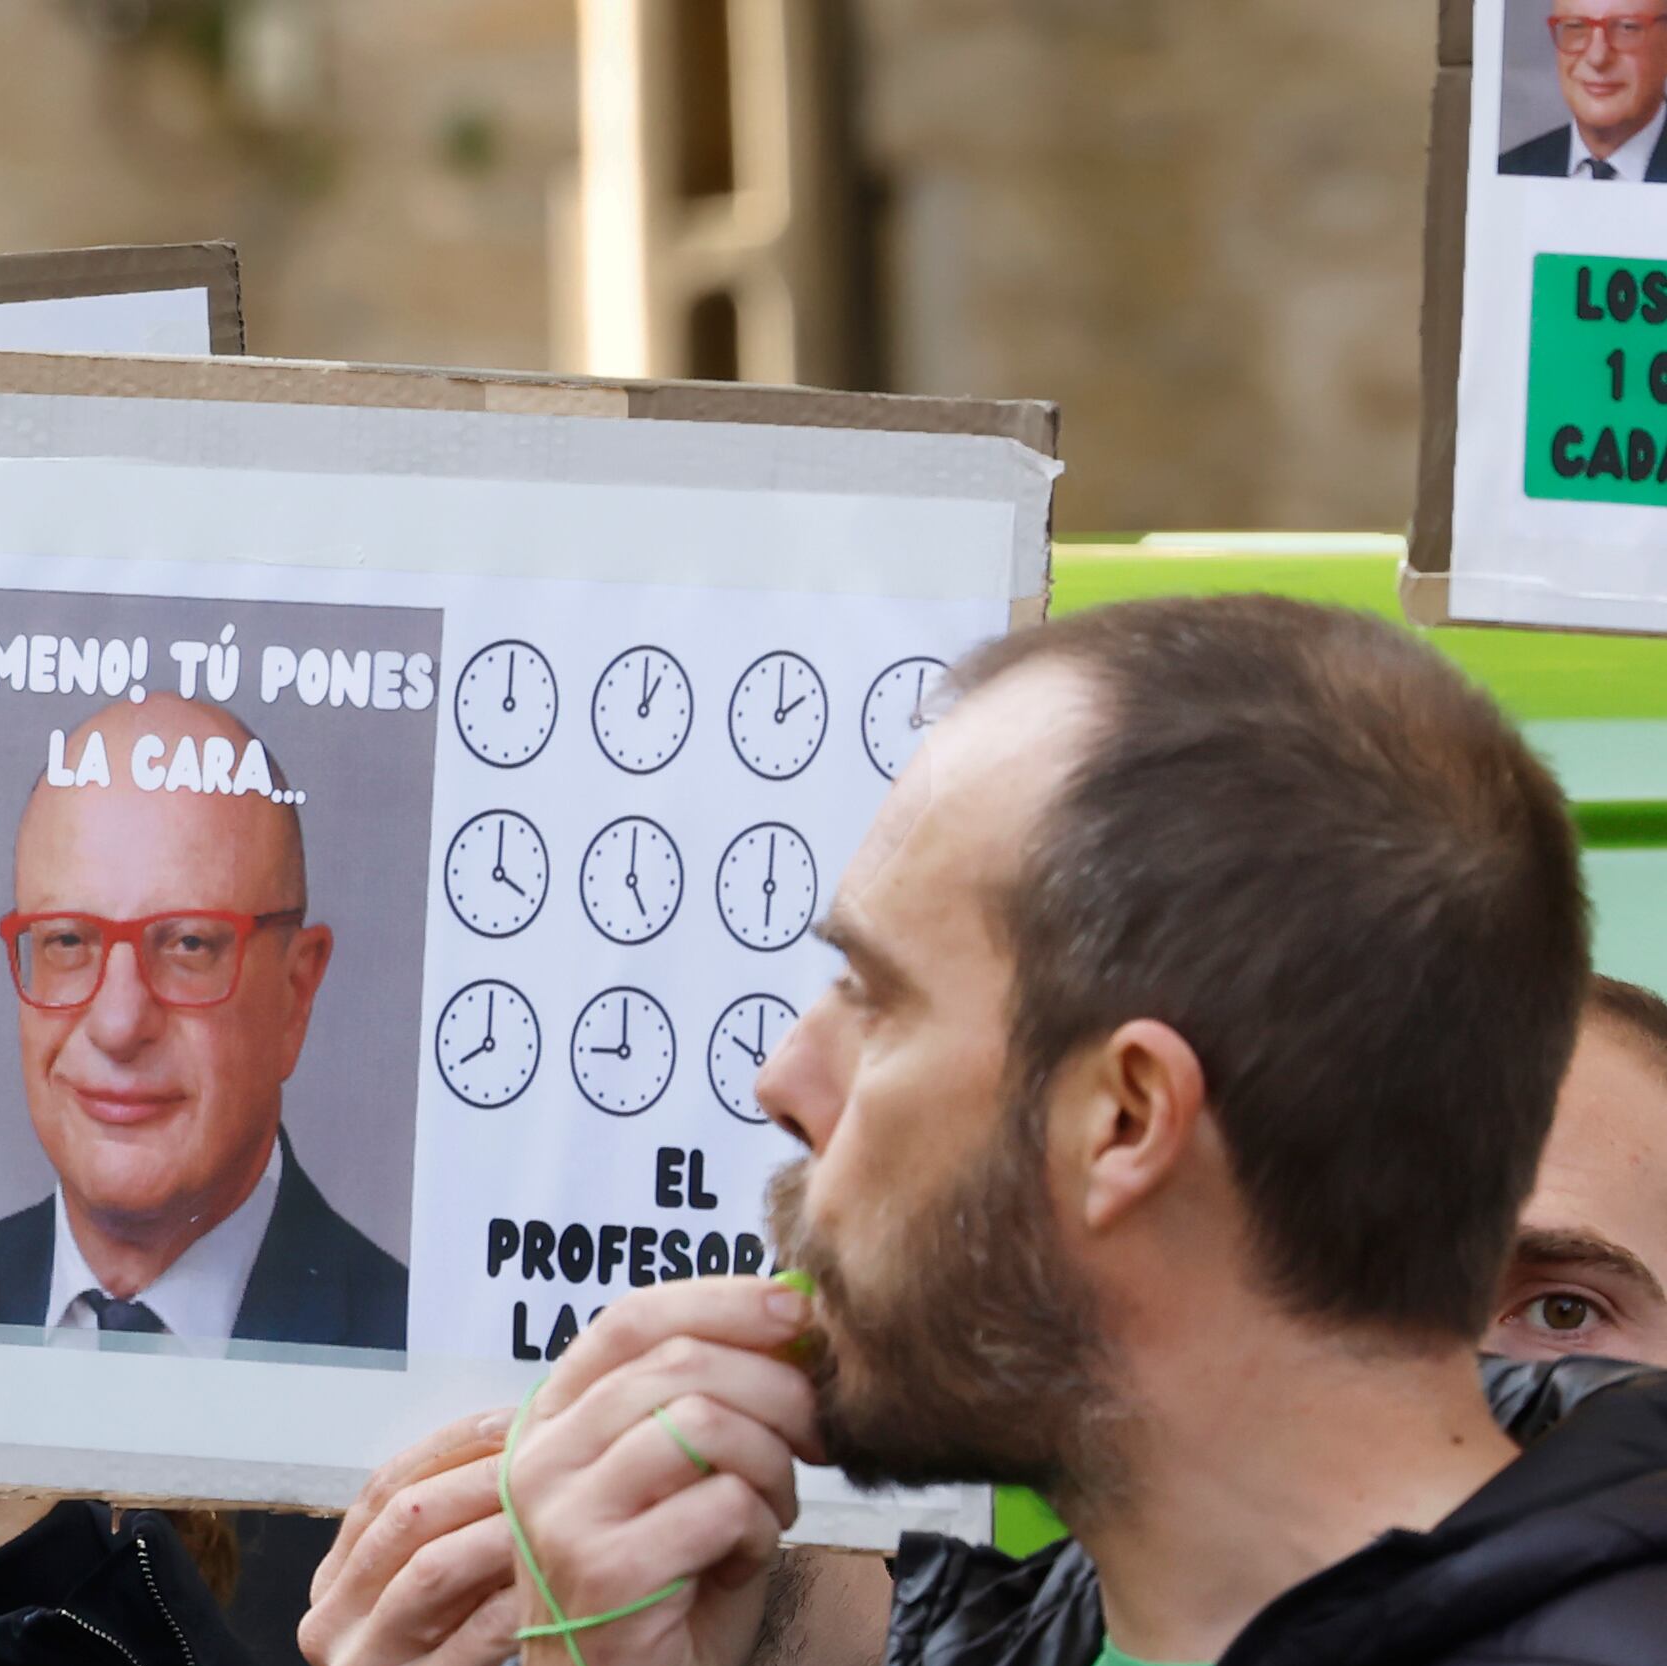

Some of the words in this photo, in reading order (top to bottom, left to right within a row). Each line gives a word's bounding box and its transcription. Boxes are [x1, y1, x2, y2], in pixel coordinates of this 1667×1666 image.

[1577, 266, 1667, 324] LOS
[1607, 348, 1624, 401] 1
[1552, 424, 1667, 483] CAD
[169, 622, 240, 702] TÚ
[260, 645, 434, 711] PONES
[47, 729, 111, 788] LA
[130, 733, 306, 804] CARA...
[655, 1147, 718, 1210] EL
[488, 1218, 777, 1287] PROFESOR
[513, 1301, 607, 1361] LA
